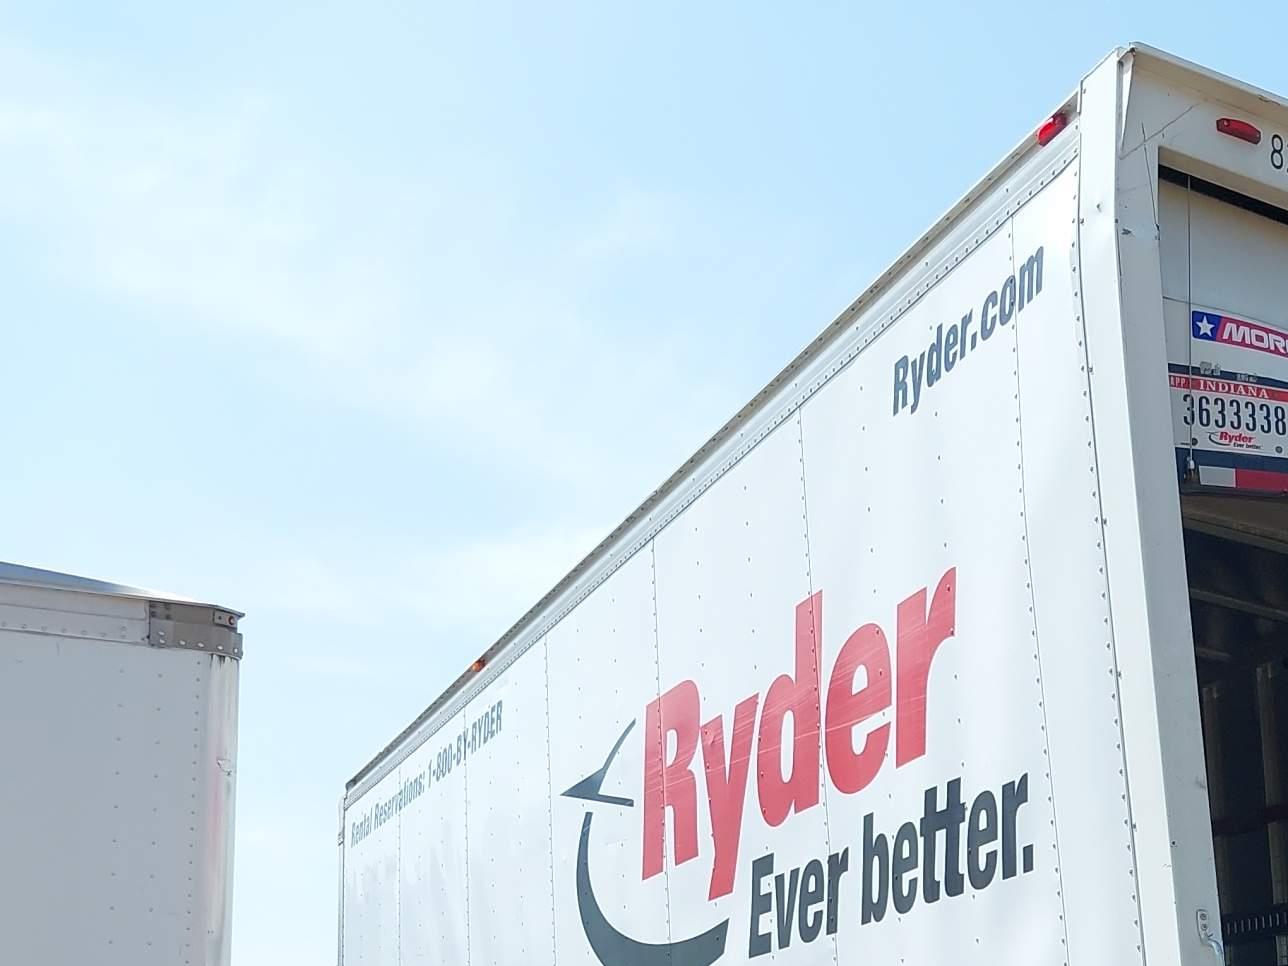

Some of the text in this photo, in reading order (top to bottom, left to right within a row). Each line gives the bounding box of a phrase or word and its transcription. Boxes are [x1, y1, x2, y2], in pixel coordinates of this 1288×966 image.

[893, 246, 1044, 417] Ryder.com
[1183, 394, 1287, 436] 3633338
[1200, 380, 1269, 399] INDIANA
[1219, 431, 1256, 444] Ryder
[642, 567, 956, 901] Ryder
[351, 807, 373, 848] Rental
[374, 771, 426, 830] Reservations:
[748, 772, 1034, 958] Ever better.
